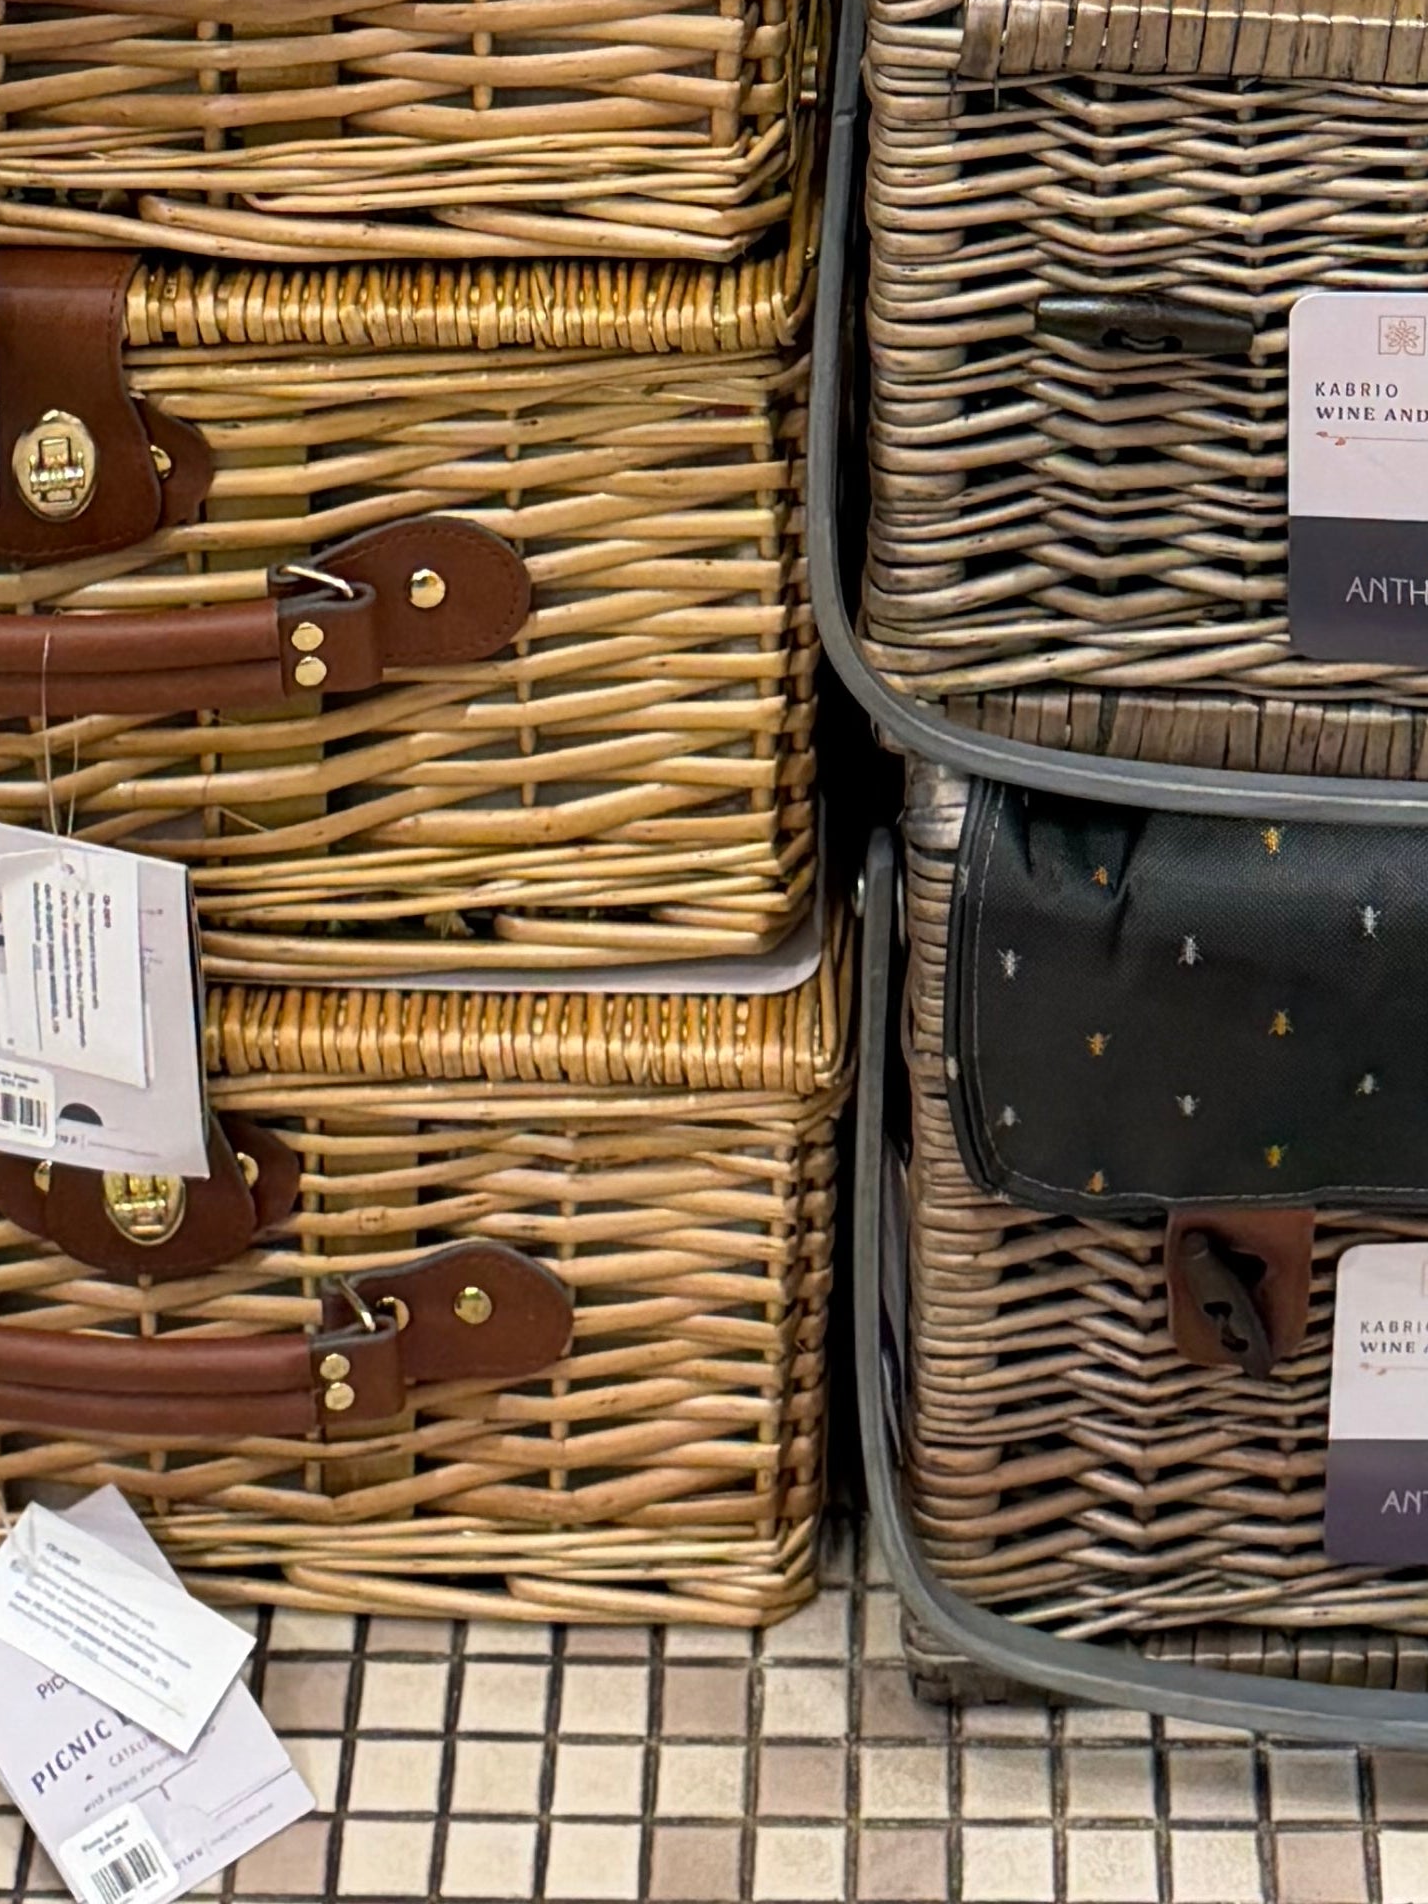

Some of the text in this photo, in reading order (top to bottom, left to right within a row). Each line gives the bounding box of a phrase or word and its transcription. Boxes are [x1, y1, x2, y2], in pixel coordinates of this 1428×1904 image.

[1315, 382, 1399, 399] KABRIO
[1315, 406, 1377, 423] WINE
[1360, 1340, 1417, 1355] WINE
[31, 1719, 113, 1795] PICNIC
